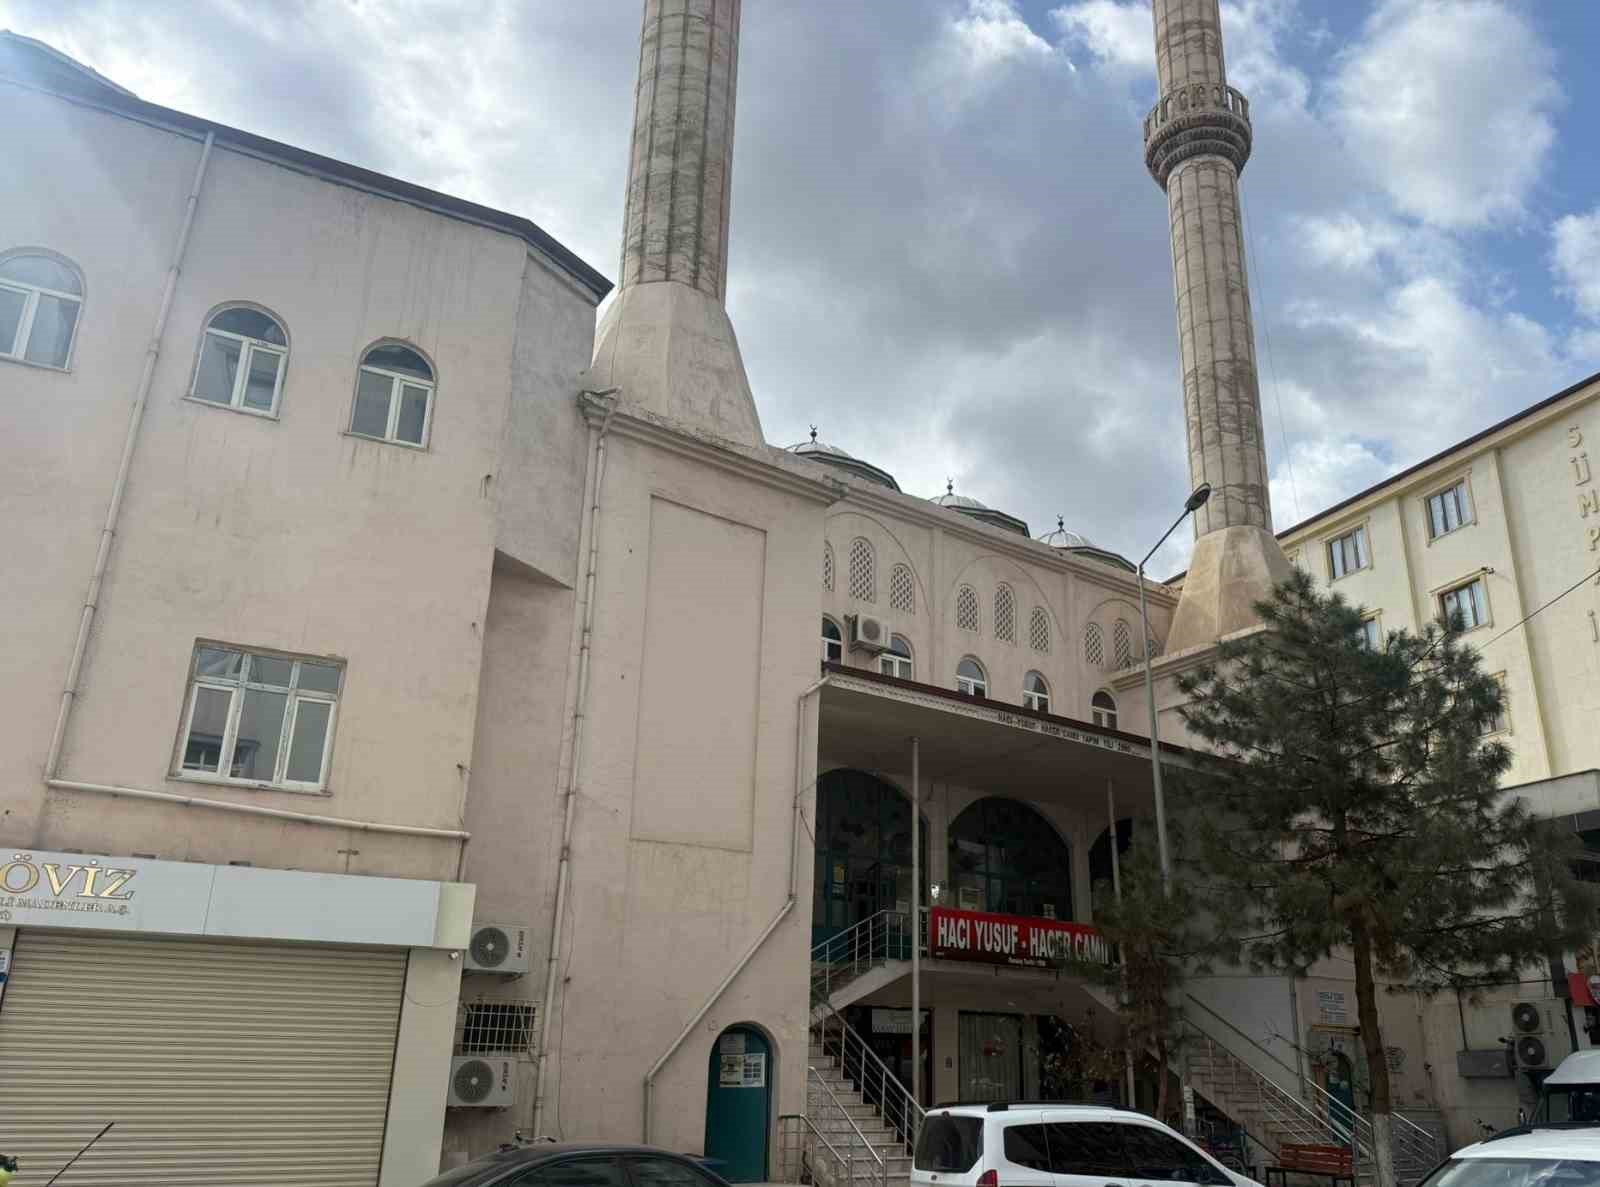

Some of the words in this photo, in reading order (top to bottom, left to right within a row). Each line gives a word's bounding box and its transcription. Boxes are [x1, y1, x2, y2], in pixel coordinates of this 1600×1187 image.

[937, 916, 971, 949] HACI
[975, 919, 1019, 955] YUSUF
[1030, 927, 1072, 961] HACER
